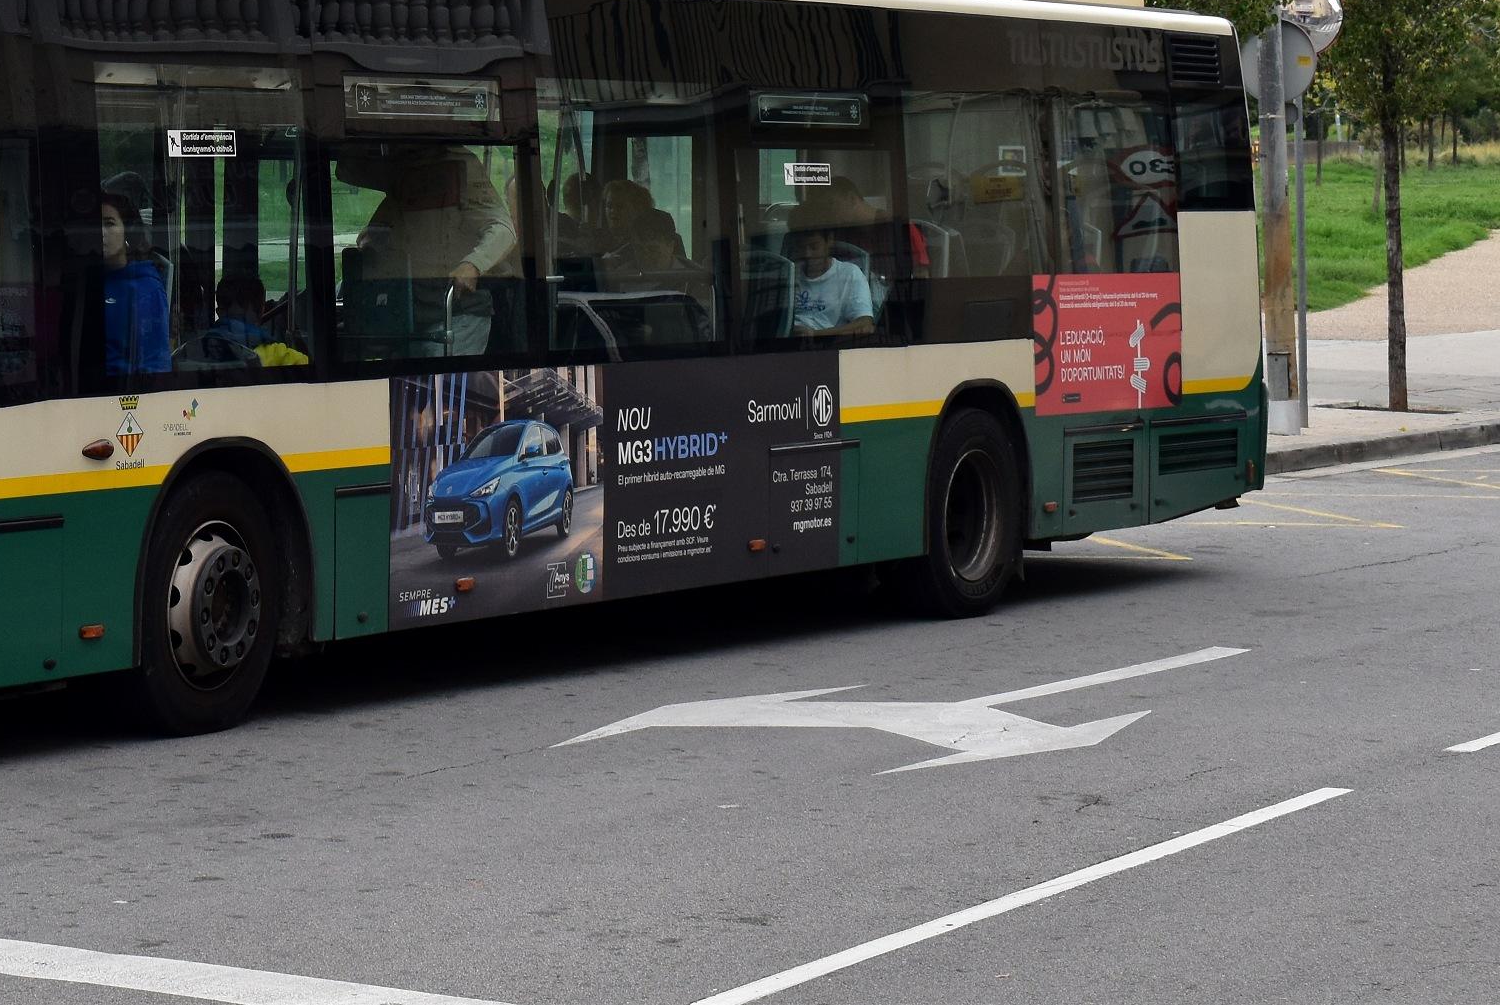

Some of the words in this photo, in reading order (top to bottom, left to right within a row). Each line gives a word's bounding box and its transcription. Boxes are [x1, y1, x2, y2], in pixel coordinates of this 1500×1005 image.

[182, 133, 200, 141] Sortida
[1060, 326, 1106, 346] L'EDUCACIÓ,
[1061, 350, 1071, 364] UN
[1061, 365, 1126, 383] D'OPORTUNITATS!
[748, 397, 801, 423] Sarmovil
[813, 386, 832, 425] MG
[617, 406, 651, 432] NOU
[116, 458, 145, 471] Sabadell
[624, 473, 643, 487] primer
[707, 466, 714, 476] de
[715, 465, 725, 475] MG
[772, 470, 789, 483] Ctra.
[790, 468, 817, 481] Terrassa
[820, 466, 833, 478] 174,
[805, 481, 833, 495] Sabadell
[790, 500, 803, 513] 937
[804, 499, 813, 512] 39
[814, 498, 822, 510] 97
[823, 496, 833, 509] 55
[617, 521, 637, 538] Des
[638, 518, 651, 536] de
[653, 506, 701, 535] 17.990
[793, 517, 832, 533] mgmotor.es
[554, 572, 570, 584] Anys
[399, 588, 432, 603] SEMPRE
